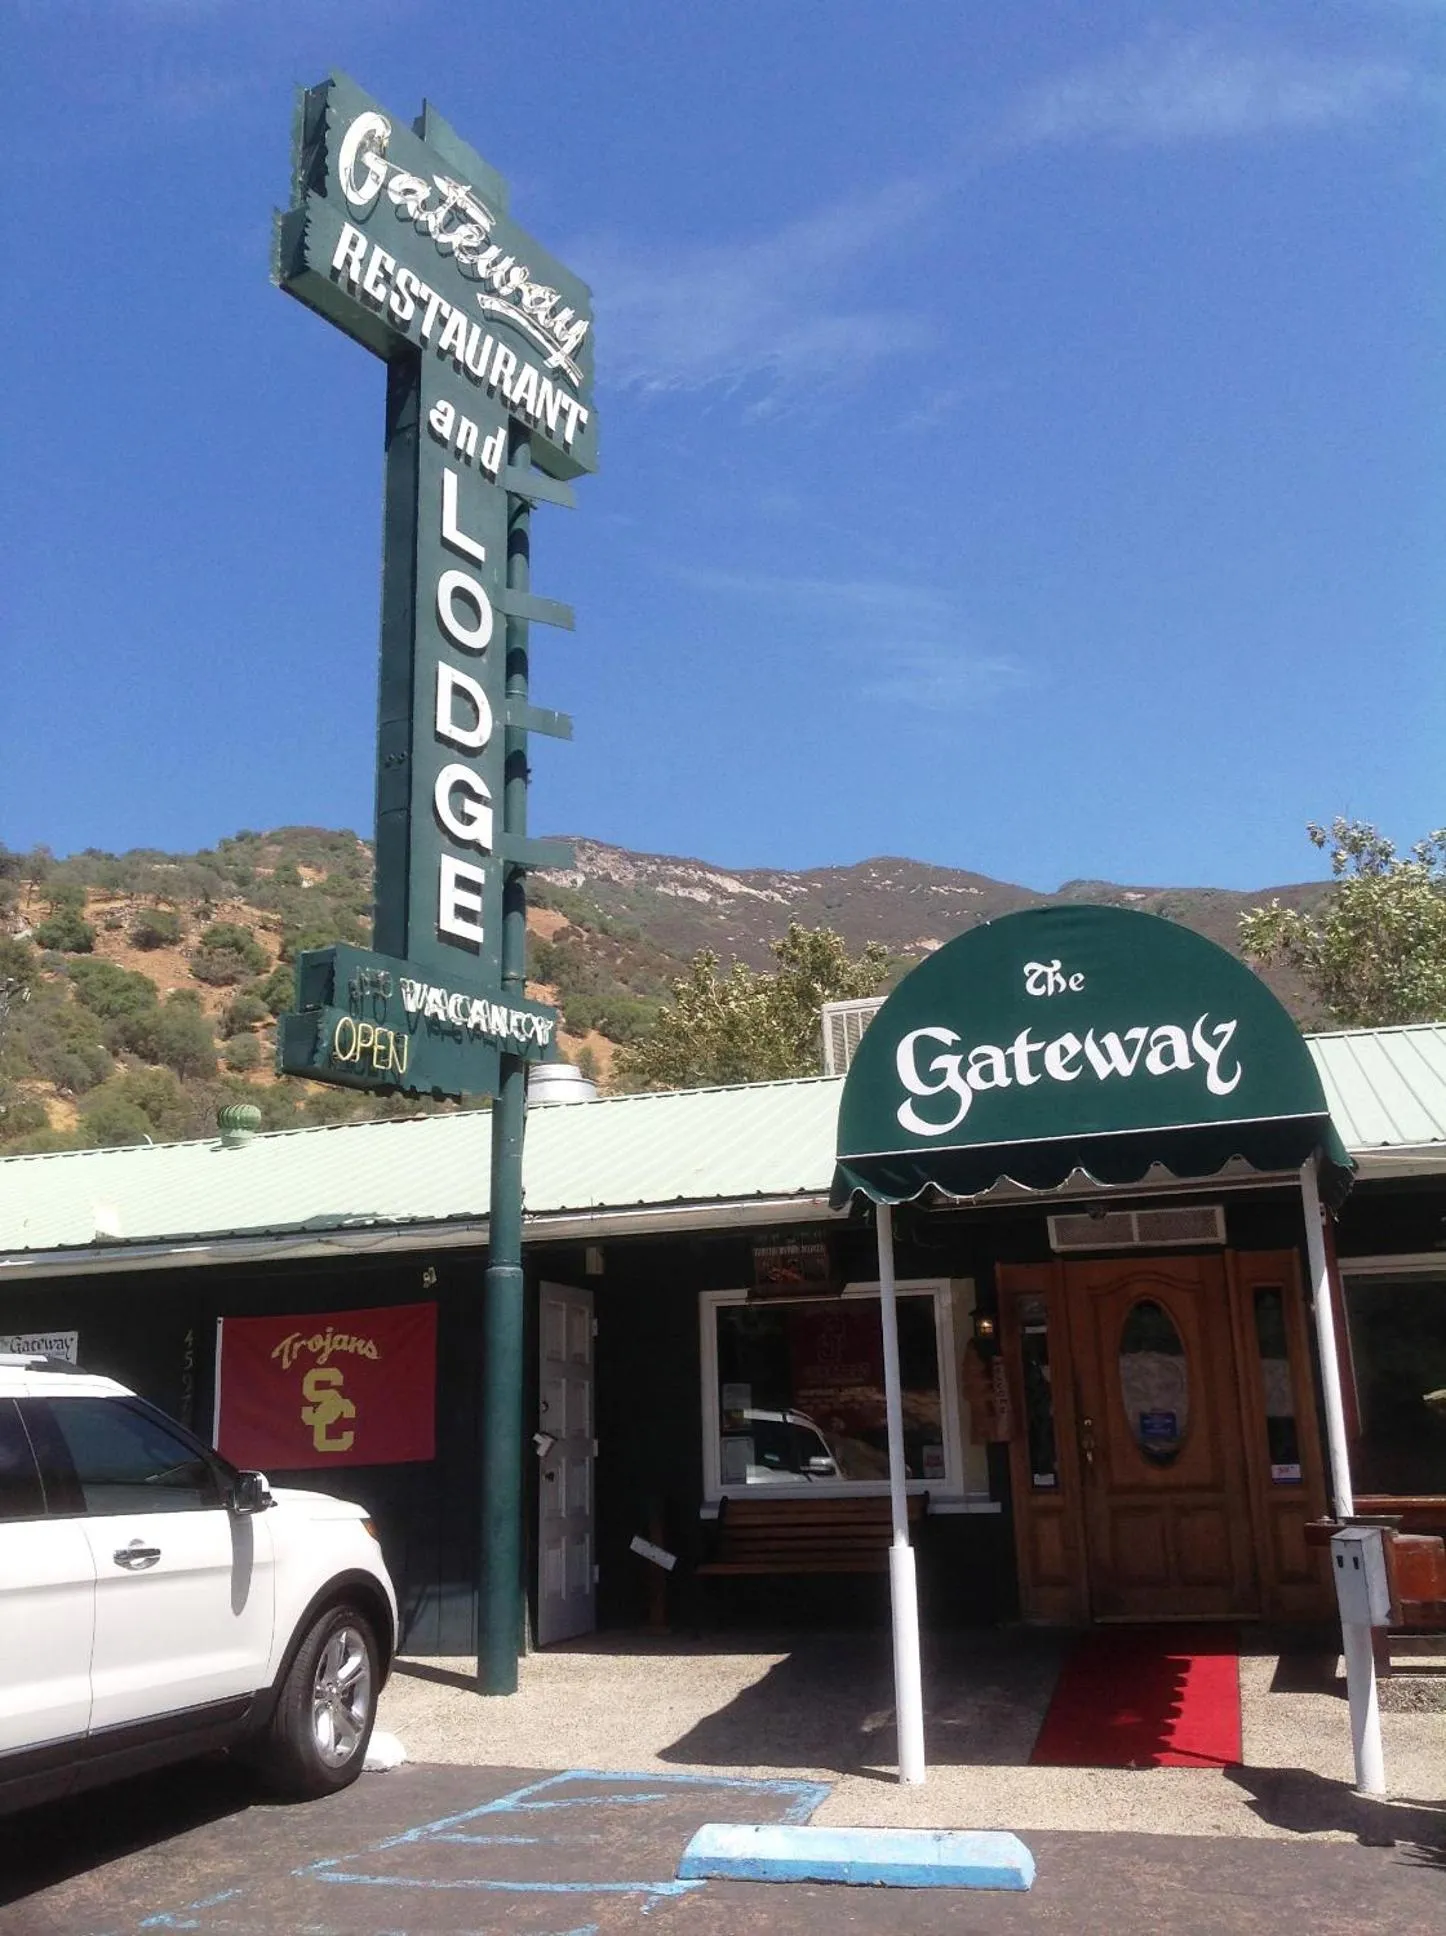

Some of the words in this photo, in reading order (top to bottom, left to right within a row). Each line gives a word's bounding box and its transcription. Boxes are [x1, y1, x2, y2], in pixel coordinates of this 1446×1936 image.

[331, 222, 588, 444] RESTAURANT
[429, 398, 508, 474] and
[434, 468, 494, 944] LODGE
[400, 977, 554, 1046] VACANCY
[1023, 959, 1085, 997] The
[335, 1016, 409, 1074] OPEN
[896, 1012, 1242, 1136] Gateway
[271, 1327, 382, 1369] Trojans
